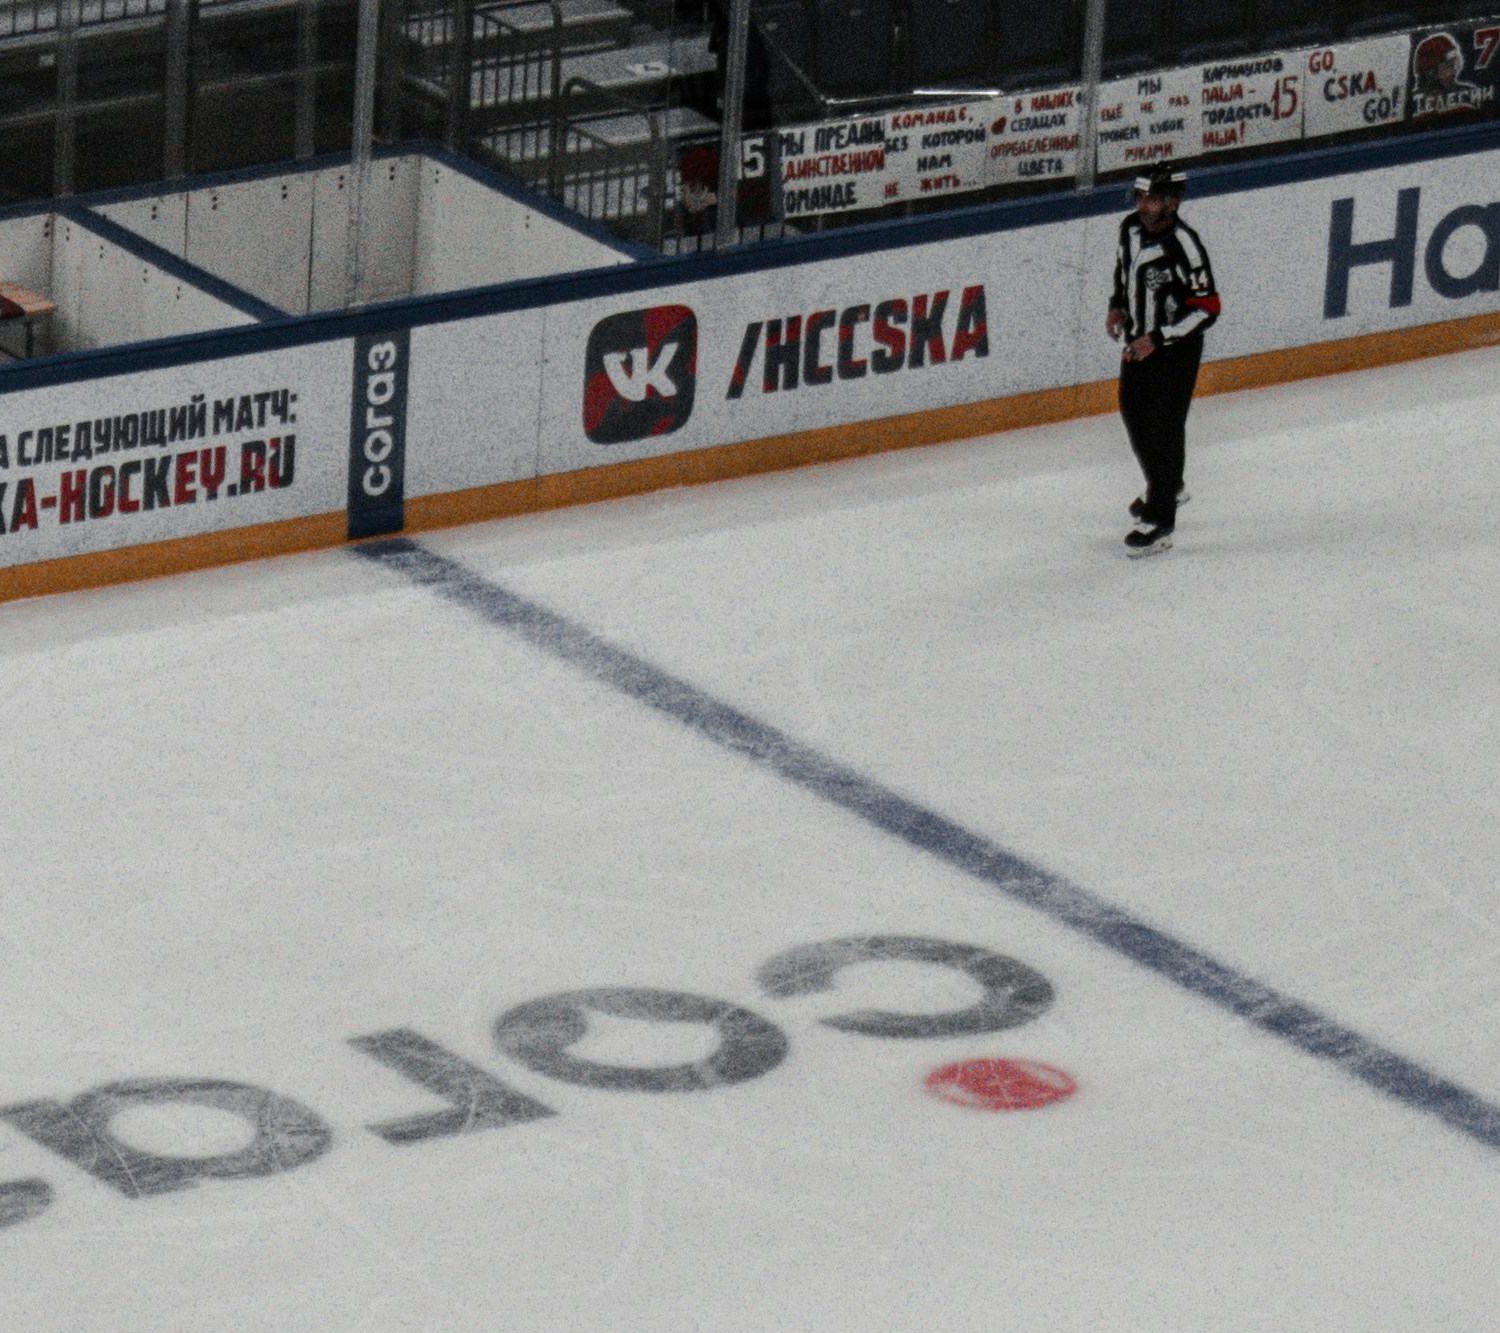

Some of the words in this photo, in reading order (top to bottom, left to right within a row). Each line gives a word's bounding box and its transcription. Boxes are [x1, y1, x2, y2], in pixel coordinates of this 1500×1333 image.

[1137, 77, 1162, 96] МЫ
[1271, 75, 1298, 121] 15
[1202, 103, 1271, 127] ГОРДОСТЬ
[1363, 86, 1399, 124] GO!
[921, 123, 985, 148] КОТОРОЙ
[784, 147, 885, 180] ДИНСТВЕННОЙ
[917, 154, 952, 171] НАМ
[1018, 158, 1065, 177] ЦВЕТА
[785, 182, 858, 213] ОМАНДЕ
[884, 182, 899, 198] НЕ
[726, 284, 989, 399] /HCCSKA
[18, 394, 205, 467] СЛЕДУЮЩИЙ
[213, 388, 297, 434] МАТЧ:
